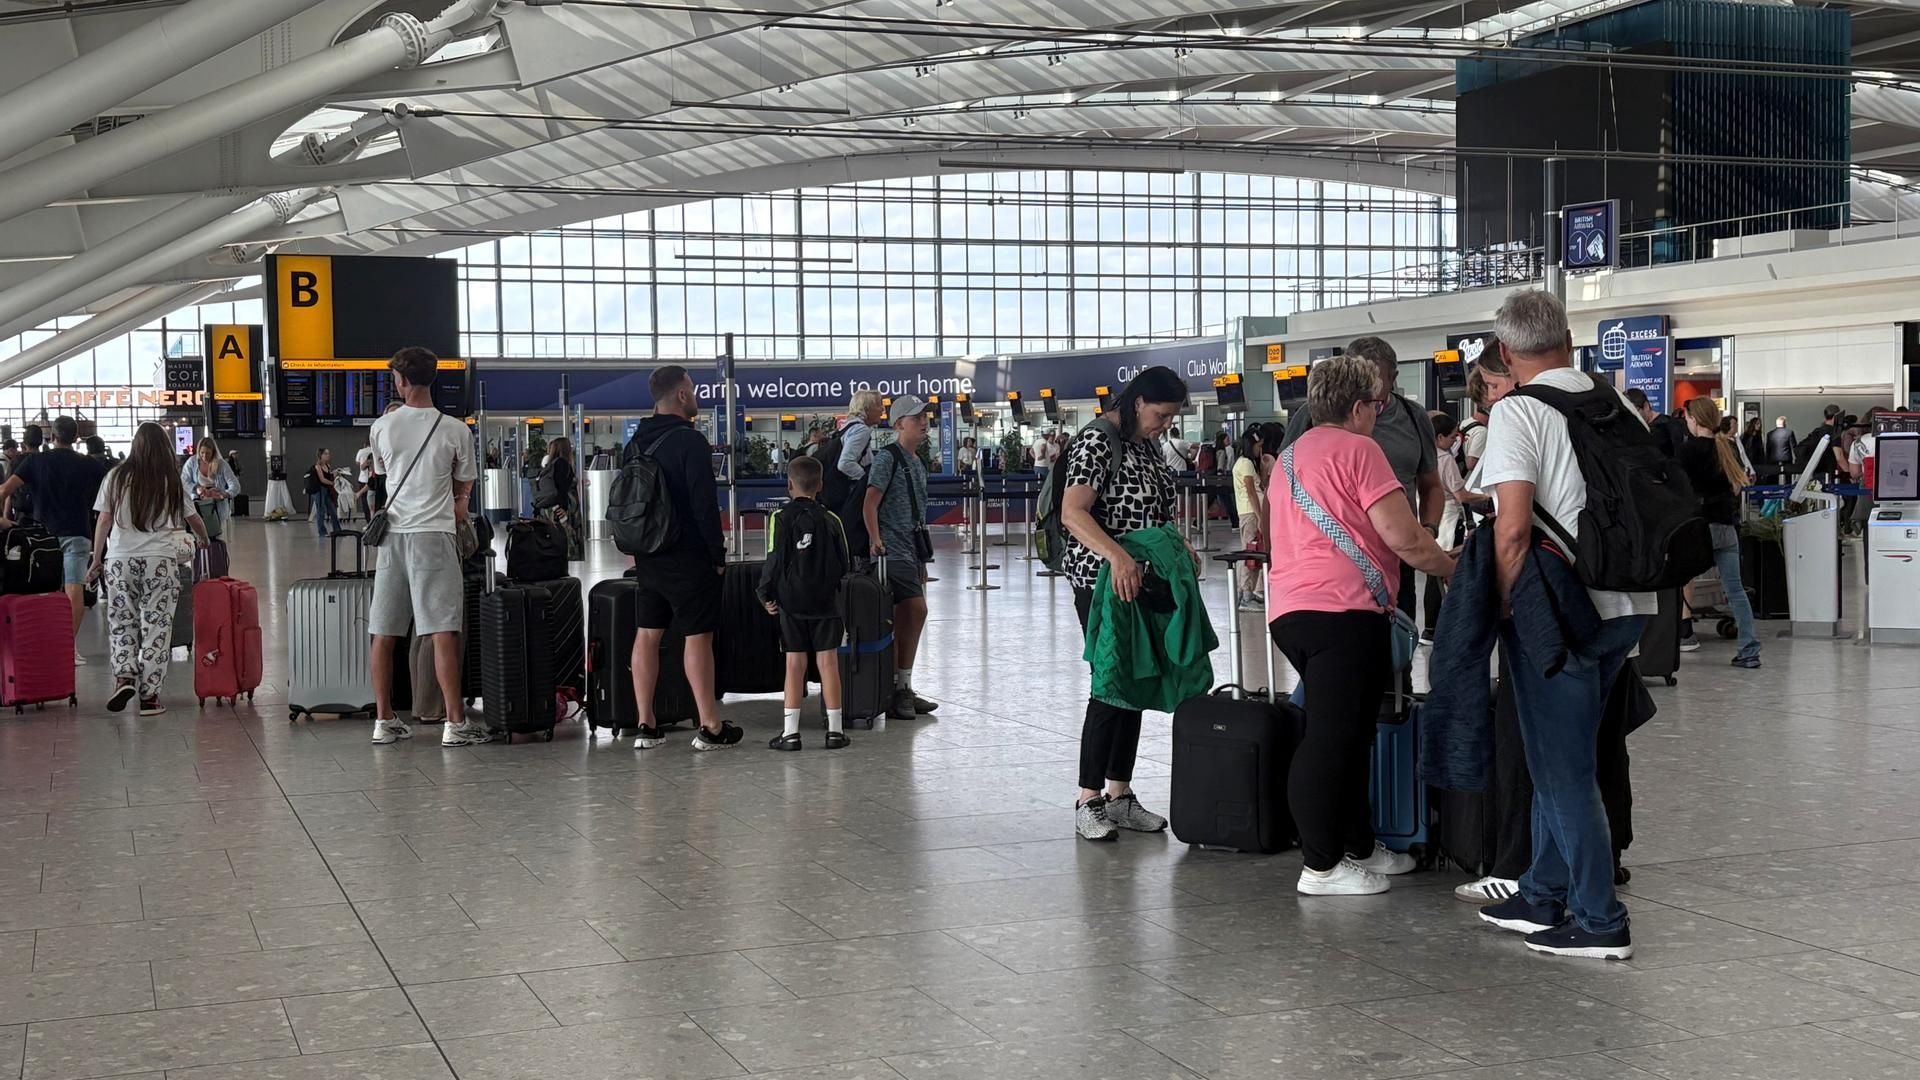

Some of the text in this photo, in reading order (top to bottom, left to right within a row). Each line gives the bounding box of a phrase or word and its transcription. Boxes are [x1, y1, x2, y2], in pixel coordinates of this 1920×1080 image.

[1573, 222, 1594, 230] AIRWAYS
[1574, 215, 1594, 223] BRITISH
[1576, 236, 1582, 260] 1
[290, 271, 319, 307] B
[1630, 329, 1657, 338] EXCESS
[218, 335, 244, 359] A
[1187, 359, 1207, 377] Club
[1208, 357, 1227, 375] Wor
[1630, 360, 1653, 368] AIRWAYS
[1631, 354, 1653, 362] BRITISH
[168, 370, 204, 381] COF
[1117, 364, 1140, 383] Club
[47, 384, 133, 406] CAFFÈ
[747, 376, 843, 399] welcome
[849, 379, 871, 396] to
[877, 379, 912, 396] our
[917, 373, 976, 395] home.
